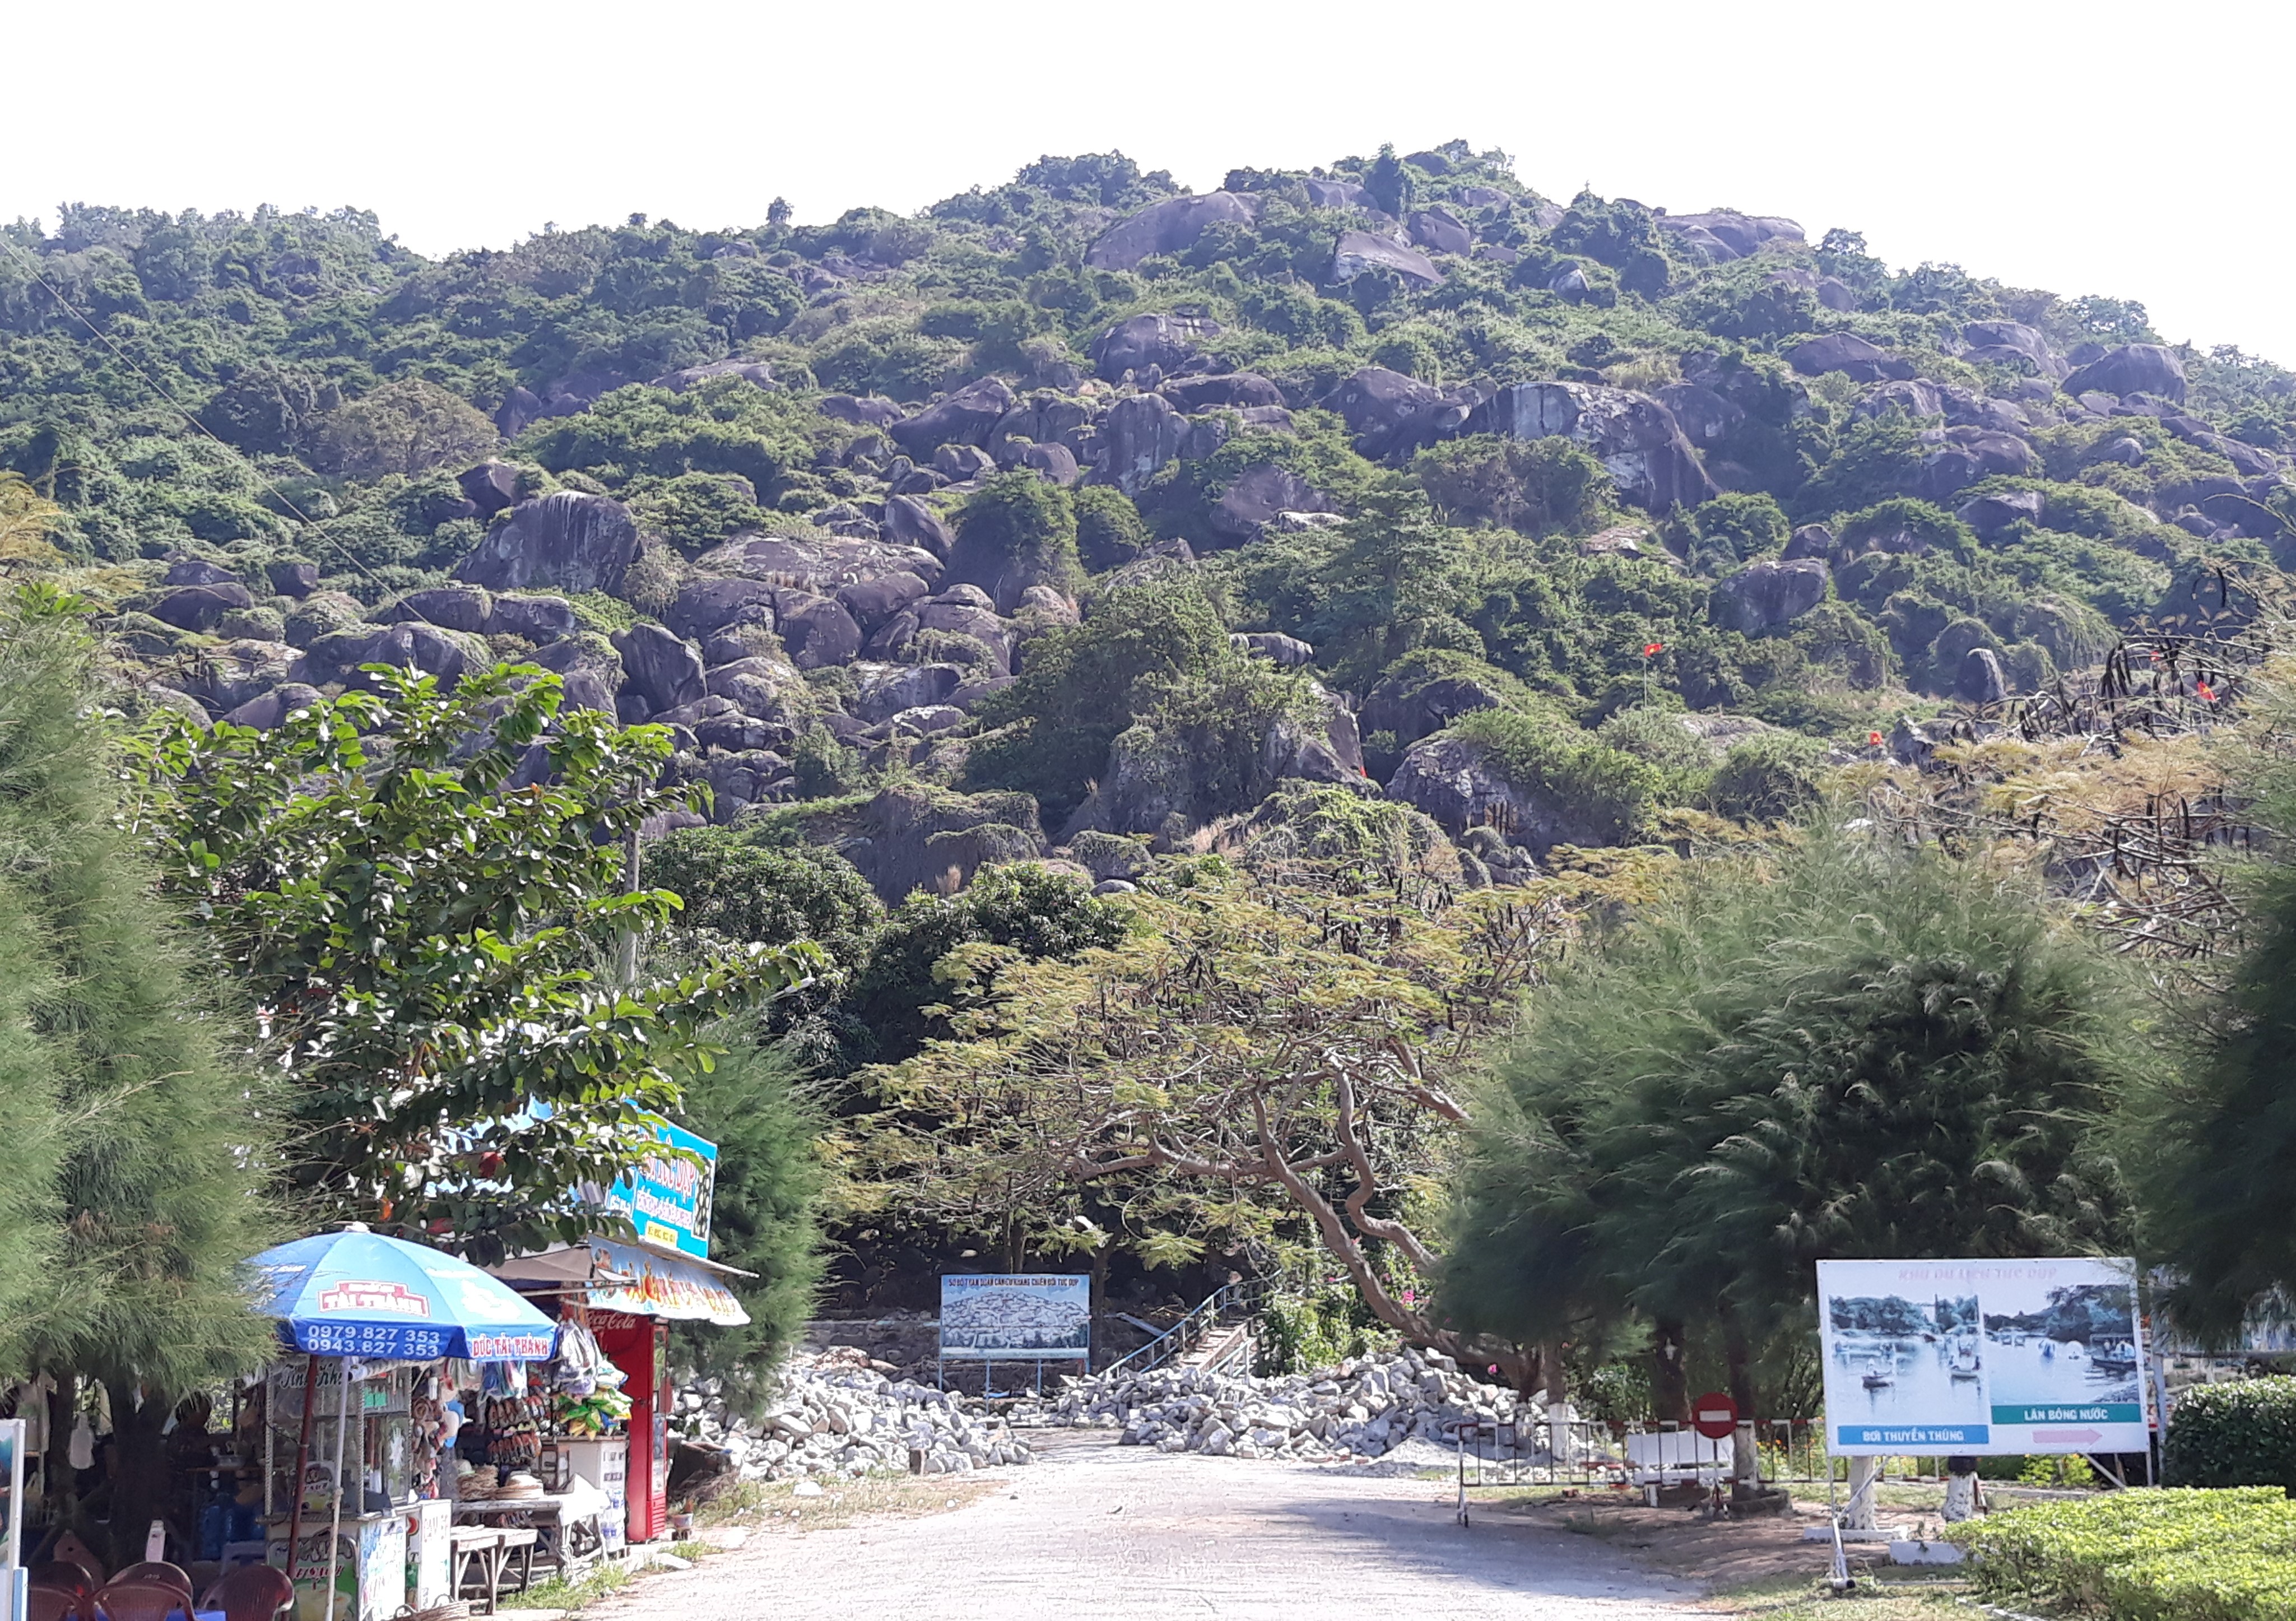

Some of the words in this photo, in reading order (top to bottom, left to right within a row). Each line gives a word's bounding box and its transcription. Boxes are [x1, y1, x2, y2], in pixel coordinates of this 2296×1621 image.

[308, 1325, 398, 1340] 0979.827
[405, 1330, 440, 1344] 353
[308, 1339, 397, 1354] 0943.827
[403, 1343, 439, 1357] 353
[2080, 1406, 2108, 1420] NƯỚC
[1862, 1430, 1881, 1442] BƠI
[1884, 1427, 1926, 1442] THUYỀN
[1928, 1428, 1964, 1441] THÚNG
